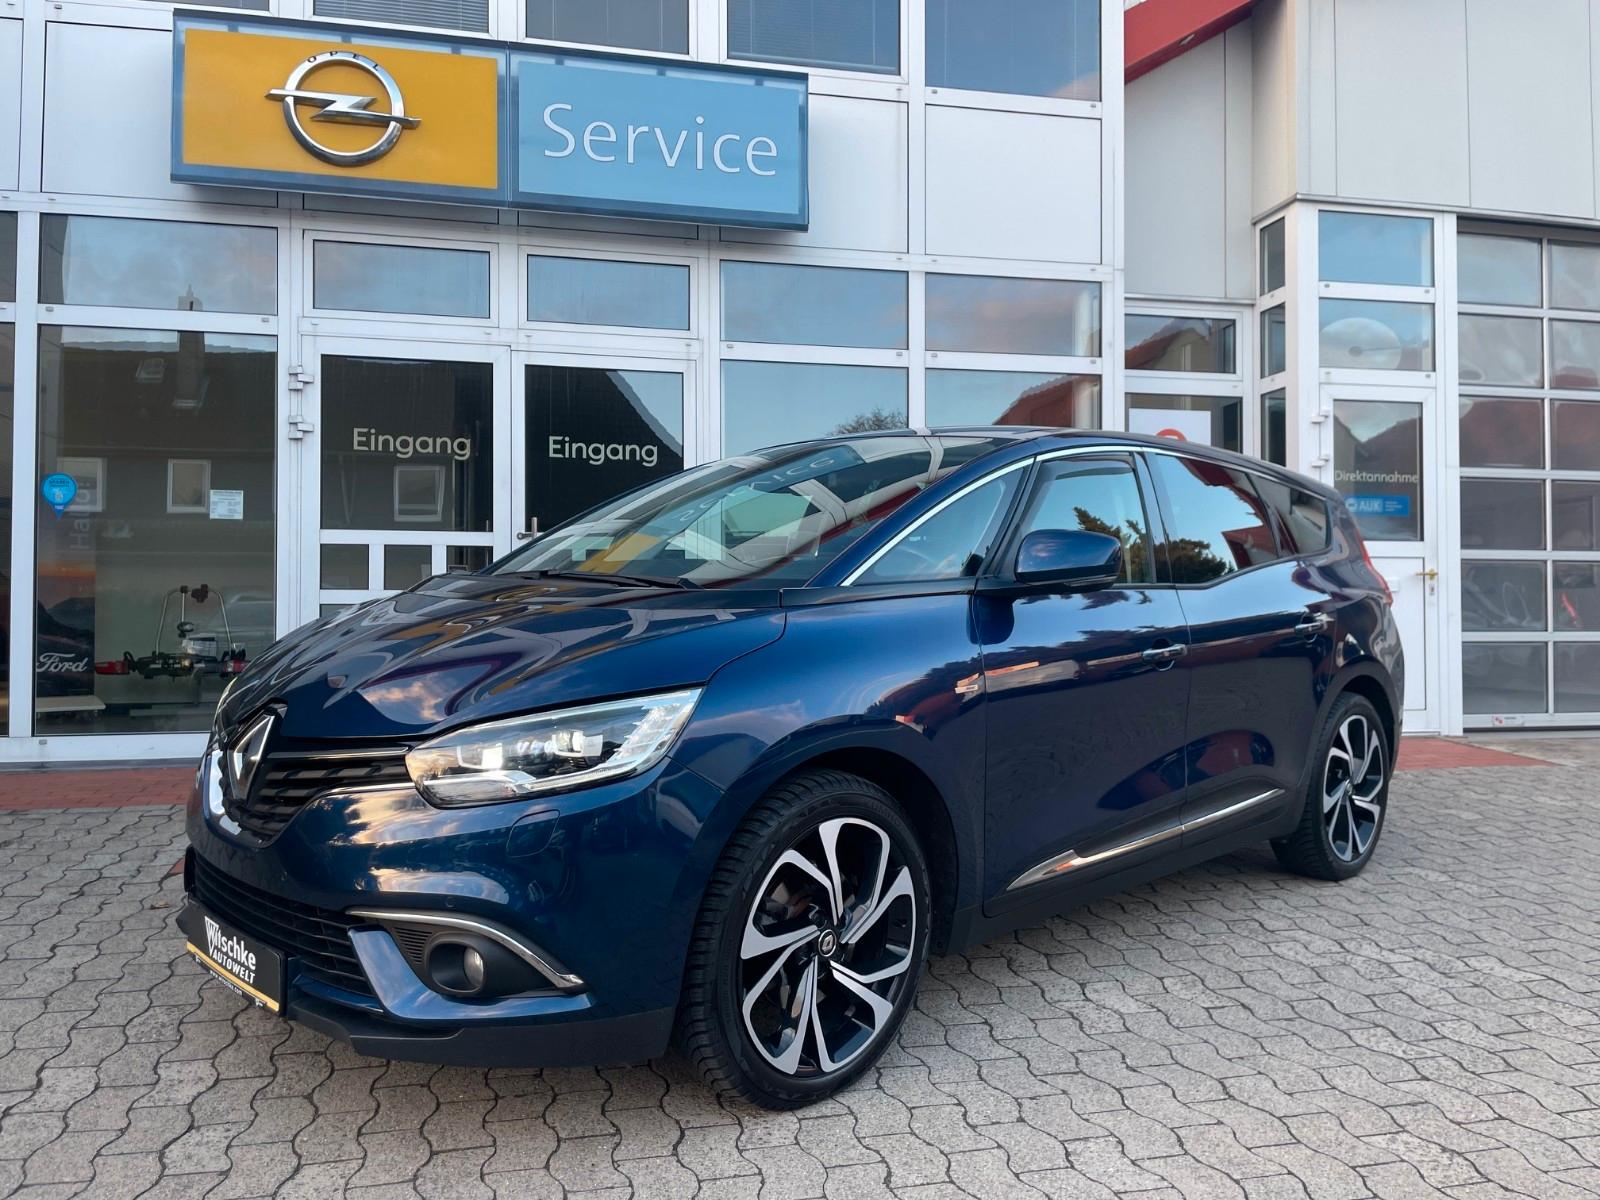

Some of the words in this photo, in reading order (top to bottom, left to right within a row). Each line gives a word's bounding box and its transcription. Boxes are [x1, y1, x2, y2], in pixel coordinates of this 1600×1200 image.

[307, 51, 379, 71] OPEL
[543, 102, 778, 176] Service
[353, 427, 471, 460] Eingang
[548, 435, 658, 467] Eingang
[1334, 470, 1418, 483] Direktannahme
[36, 652, 88, 673] Ford
[204, 916, 256, 970] Witschke
[213, 949, 255, 984] AUTOWELT
